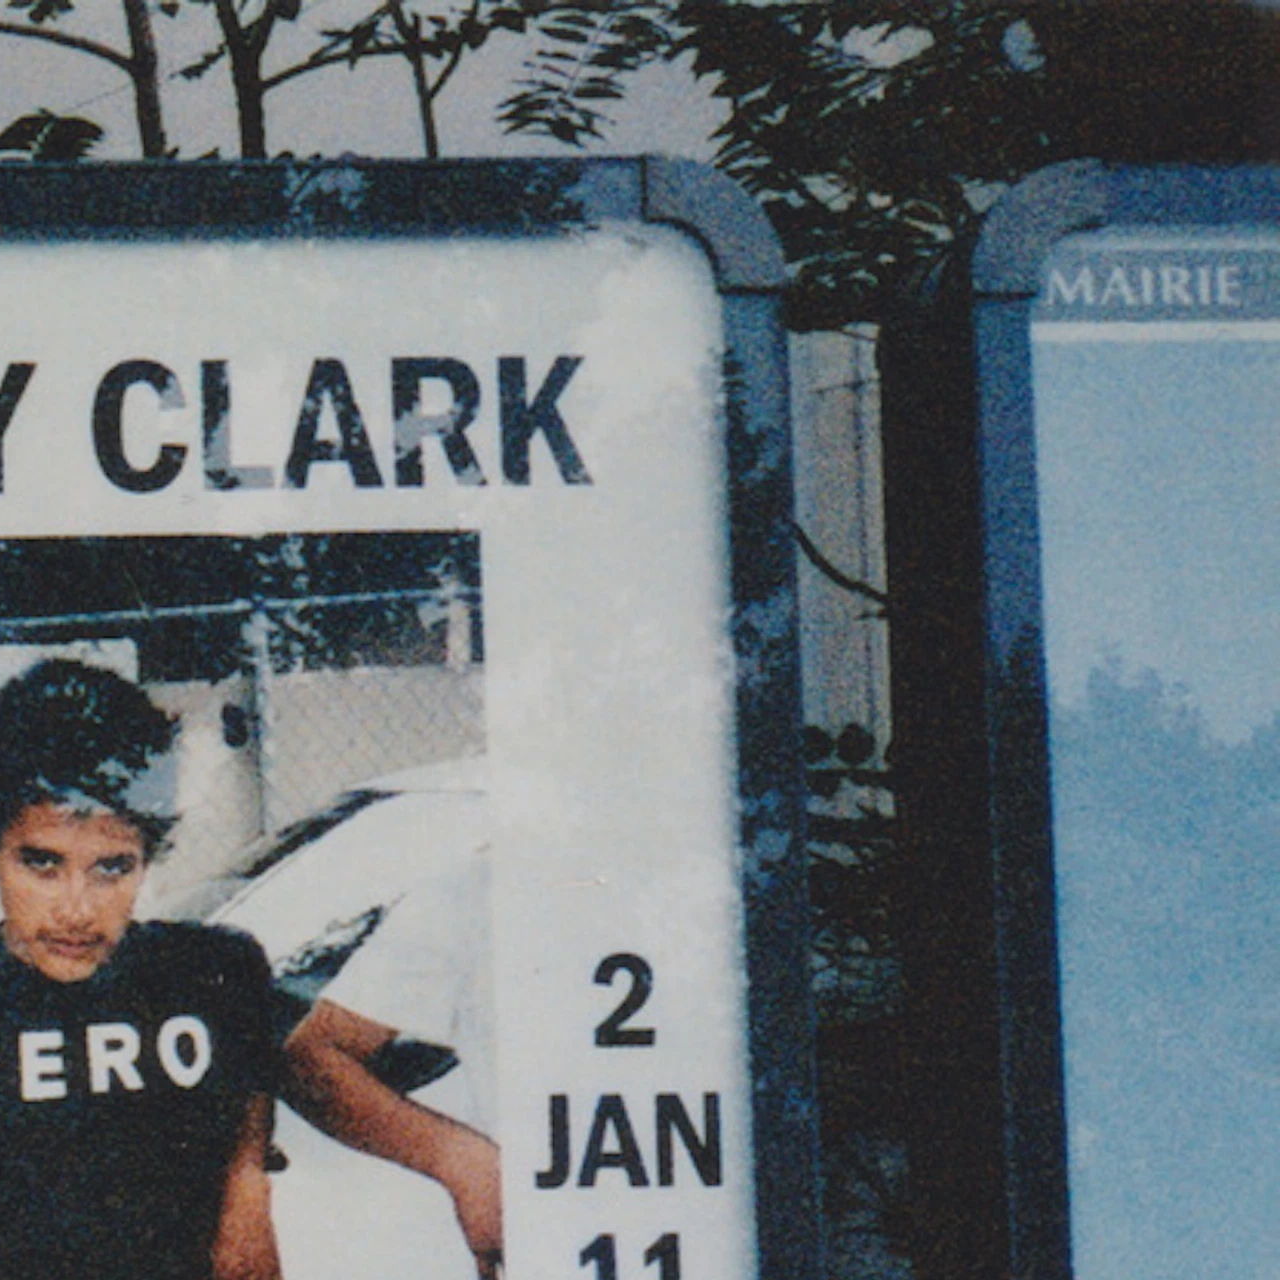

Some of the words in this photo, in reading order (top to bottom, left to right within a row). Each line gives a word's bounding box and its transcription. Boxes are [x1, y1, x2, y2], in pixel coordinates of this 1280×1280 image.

[1044, 265, 1243, 306] MAIRIE
[90, 354, 594, 493] CLARK
[592, 951, 657, 1048] 2
[534, 1091, 724, 1190] JAN
